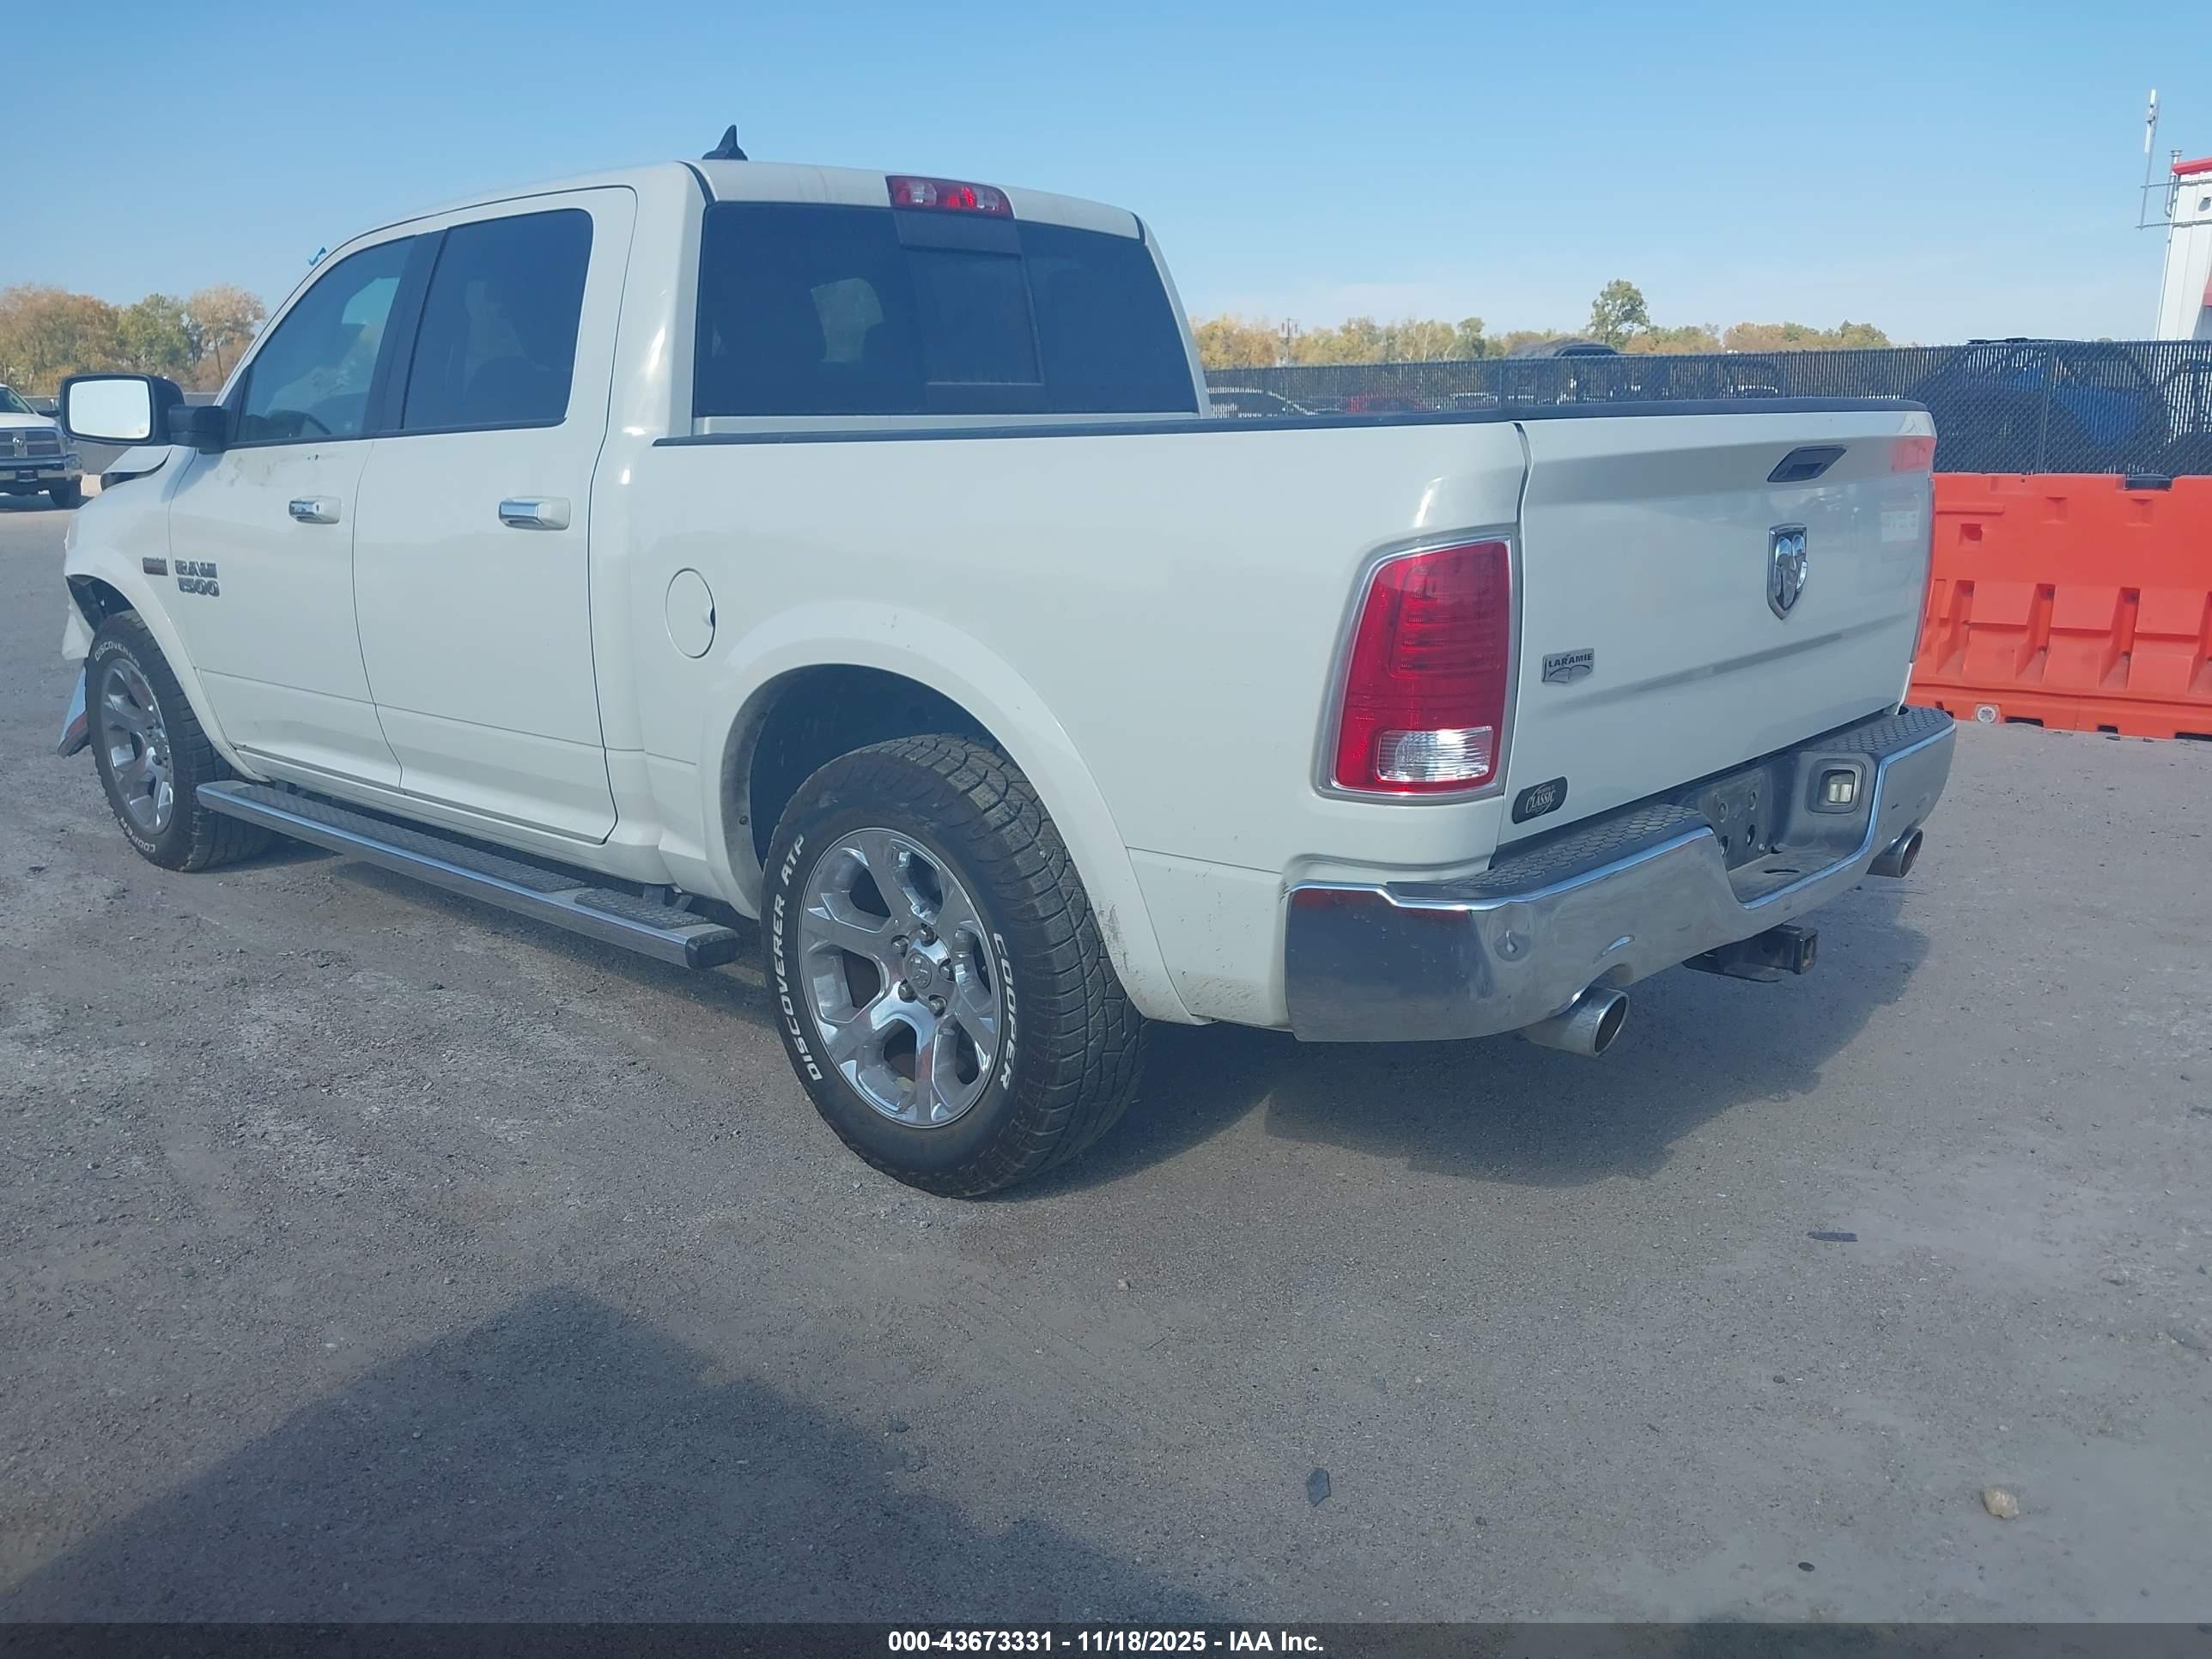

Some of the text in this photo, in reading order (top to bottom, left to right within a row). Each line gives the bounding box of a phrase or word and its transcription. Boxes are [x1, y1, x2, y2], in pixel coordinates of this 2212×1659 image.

[174, 560, 218, 579] RAM
[177, 577, 221, 598] 1500
[1548, 653, 1593, 667] LARAMIE
[1525, 789, 1556, 814] CLASSIC
[773, 833, 823, 1081] DISCOVERER ATP
[993, 933, 1017, 1090] COOPER
